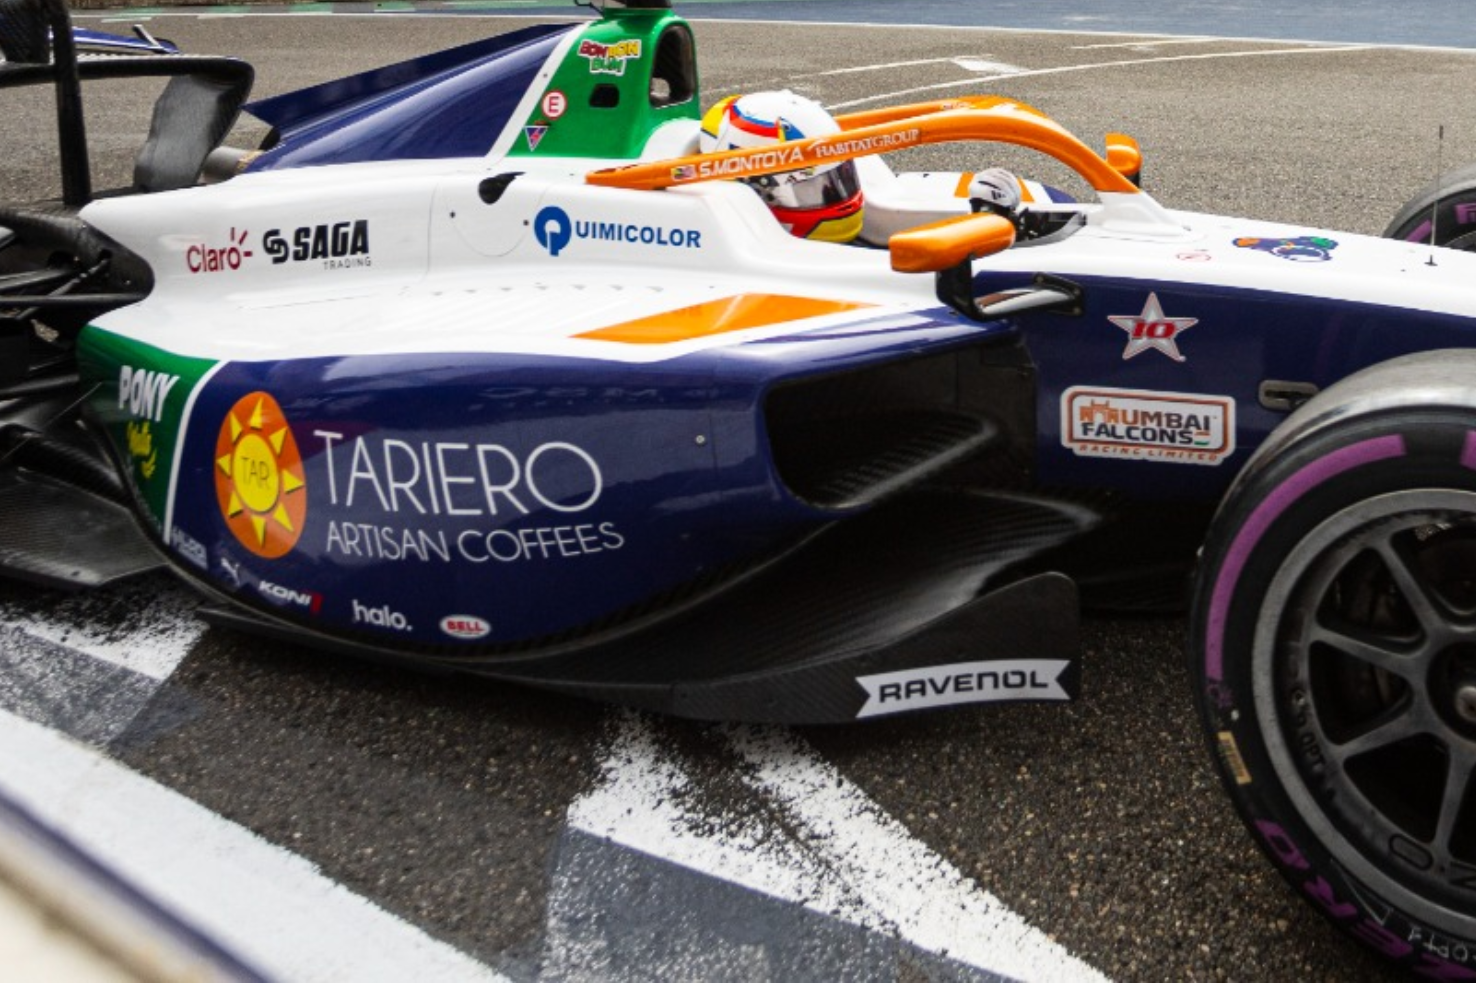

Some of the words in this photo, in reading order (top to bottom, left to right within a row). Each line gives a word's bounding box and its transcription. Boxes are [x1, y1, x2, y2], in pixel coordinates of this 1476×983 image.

[548, 95, 560, 114] E
[700, 145, 804, 179] S.MONTOYA
[186, 235, 247, 274] Claro
[293, 219, 370, 262] SAGA
[323, 256, 372, 271] TRADING
[1131, 321, 1177, 340] 10
[119, 364, 181, 423] PONY
[1079, 401, 1210, 432] MUMBAI
[1081, 421, 1194, 446] FALCONS
[1079, 444, 1141, 456] RACING
[1148, 449, 1219, 463] LIMITED
[240, 456, 272, 493] TAR
[313, 428, 603, 517] TARIERO
[326, 520, 451, 563] ARTISAN
[457, 521, 626, 563] COFFEES
[257, 580, 313, 607] KONI
[446, 619, 486, 632] BELL
[878, 670, 1049, 704] RAVENOL
